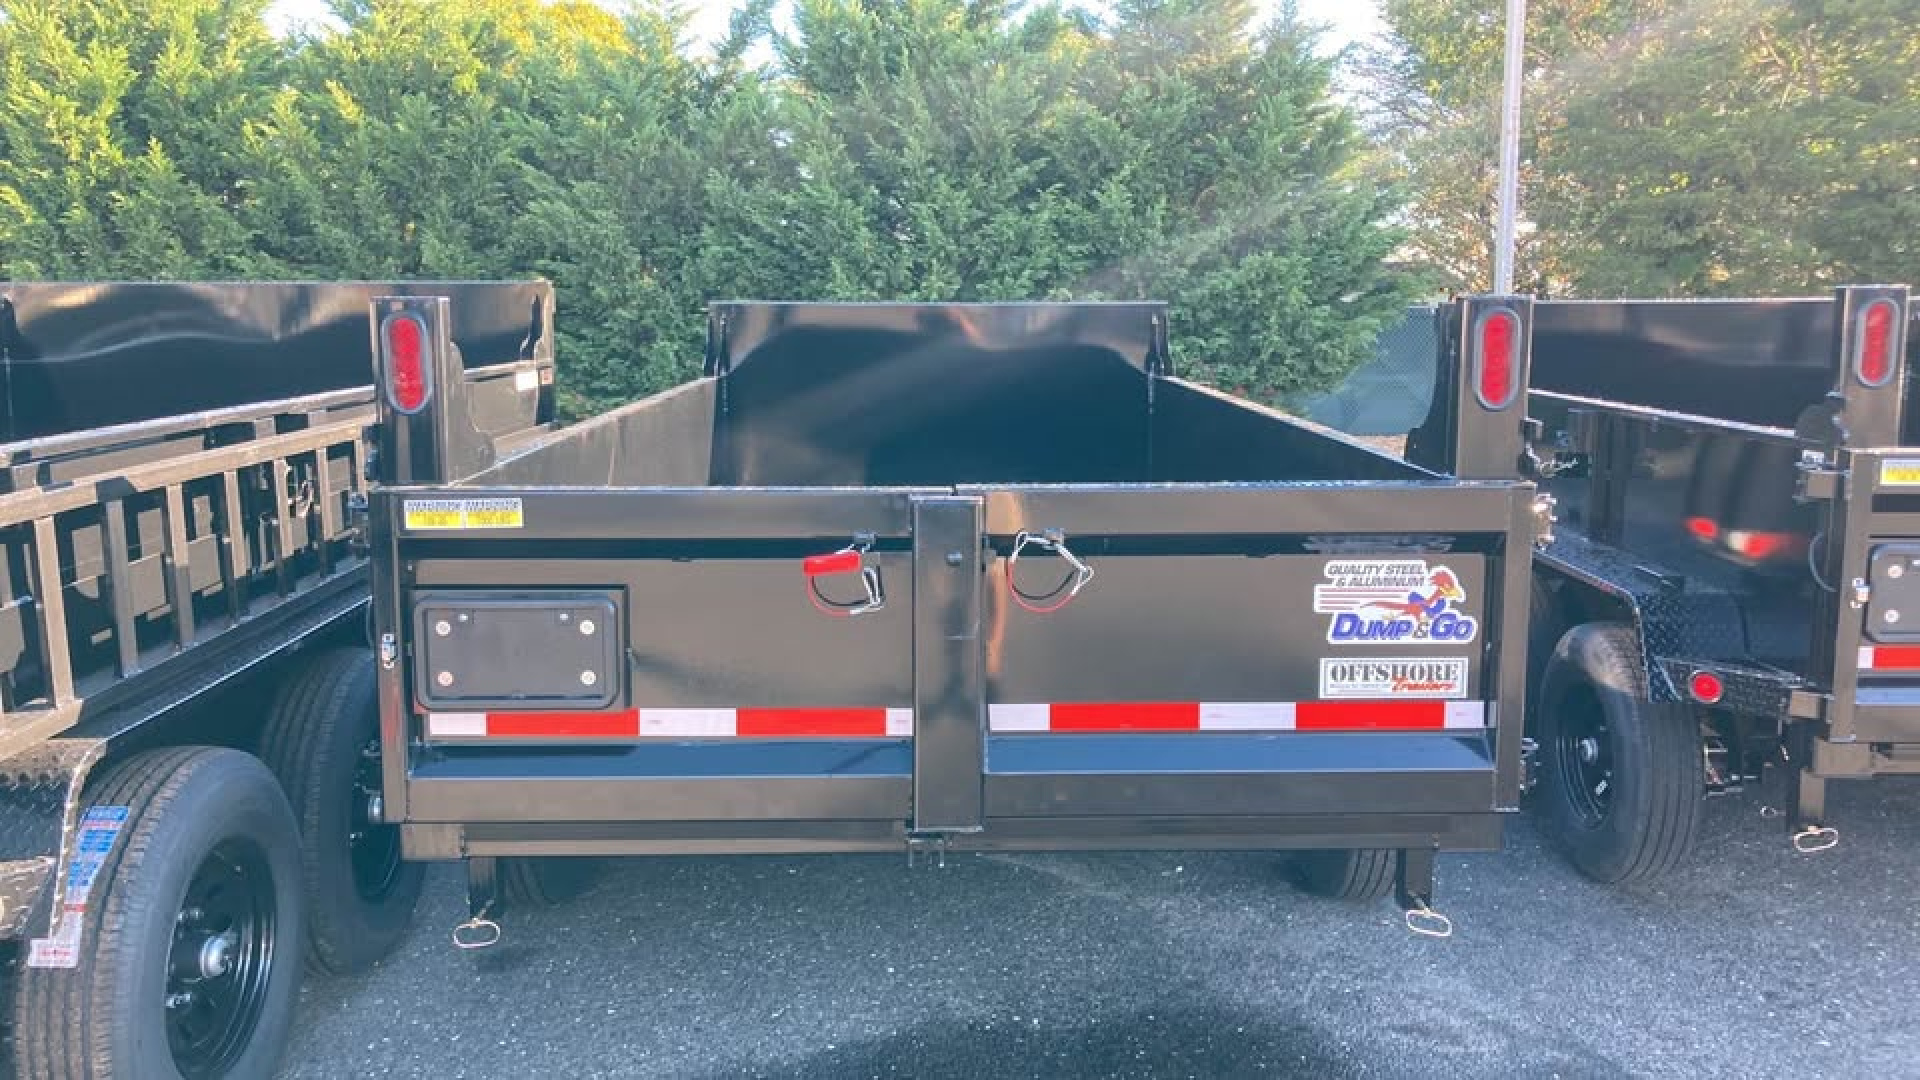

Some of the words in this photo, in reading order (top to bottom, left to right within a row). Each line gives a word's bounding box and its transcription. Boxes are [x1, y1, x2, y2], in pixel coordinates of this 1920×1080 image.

[1328, 563, 1384, 575] QUALITY
[1385, 563, 1425, 575] STEEL
[1331, 663, 1460, 682] OFFSHORE
